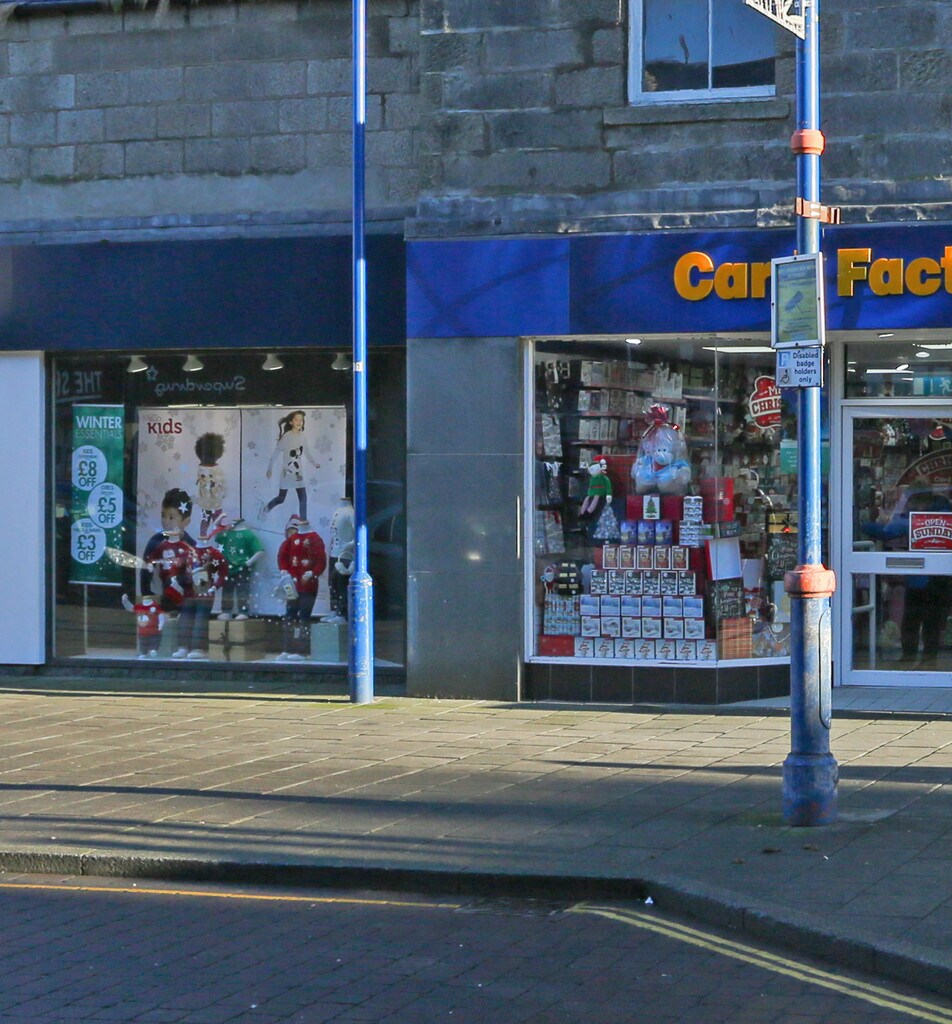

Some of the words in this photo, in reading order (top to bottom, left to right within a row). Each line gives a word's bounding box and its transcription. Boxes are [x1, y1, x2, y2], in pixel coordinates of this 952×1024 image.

[674, 251, 771, 301] Car
[793, 351, 819, 359] Disabled
[752, 397, 781, 414] CHRIS
[76, 415, 122, 429] WINTER
[147, 417, 182, 434] kids
[75, 429, 122, 439] ESSENTIALS
[78, 461, 97, 477] £8
[79, 477, 96, 487] OFF
[98, 497, 116, 514] £5
[98, 514, 115, 523] OFF
[924, 518, 946, 527] OPEN
[77, 535, 96, 551] £3
[78, 551, 95, 560] OFF
